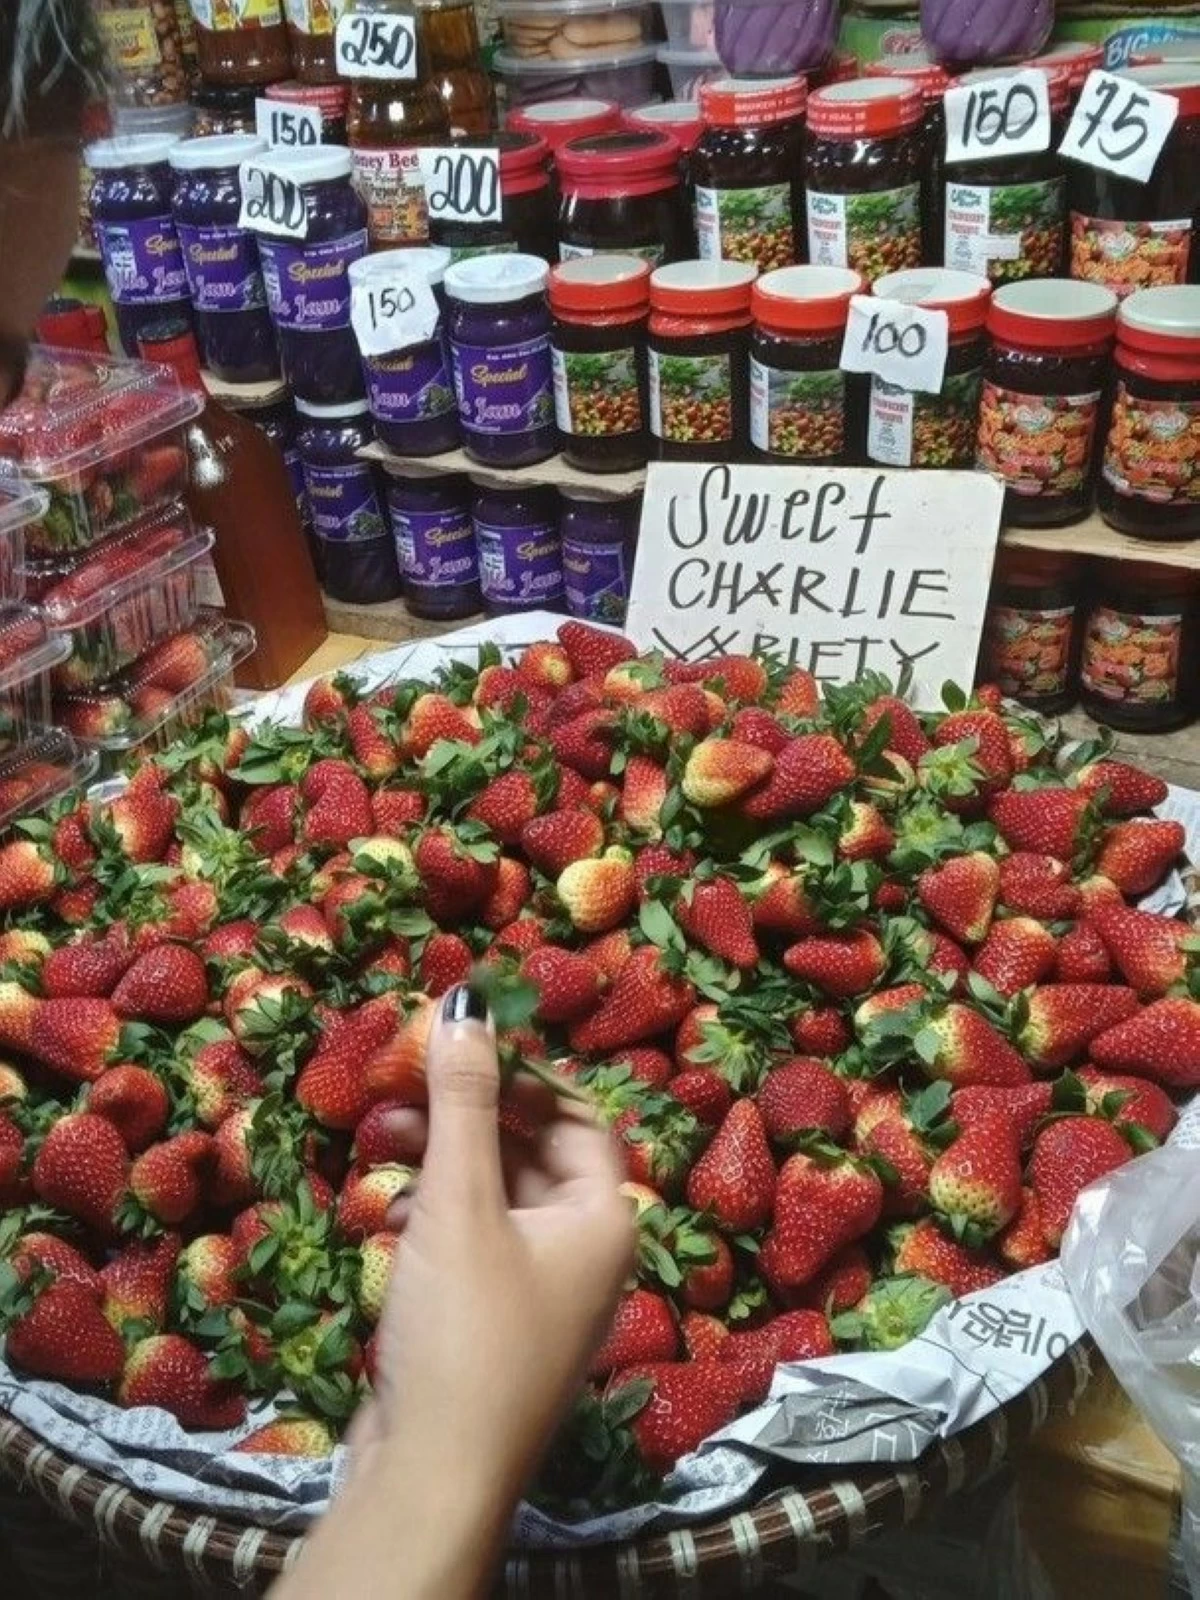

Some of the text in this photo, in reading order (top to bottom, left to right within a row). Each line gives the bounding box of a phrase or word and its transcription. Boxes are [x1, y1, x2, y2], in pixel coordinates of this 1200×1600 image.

[341, 18, 414, 70] 250
[271, 111, 317, 145] 150
[961, 83, 1038, 148] 150
[1077, 79, 1150, 161] 75
[389, 153, 419, 168] Bee
[246, 168, 305, 230] 200
[430, 154, 497, 216] 200
[287, 259, 345, 284] Special
[368, 287, 416, 331] 150
[862, 313, 927, 357] 100
[470, 363, 528, 388] Special
[668, 558, 956, 621] CHARLIE
